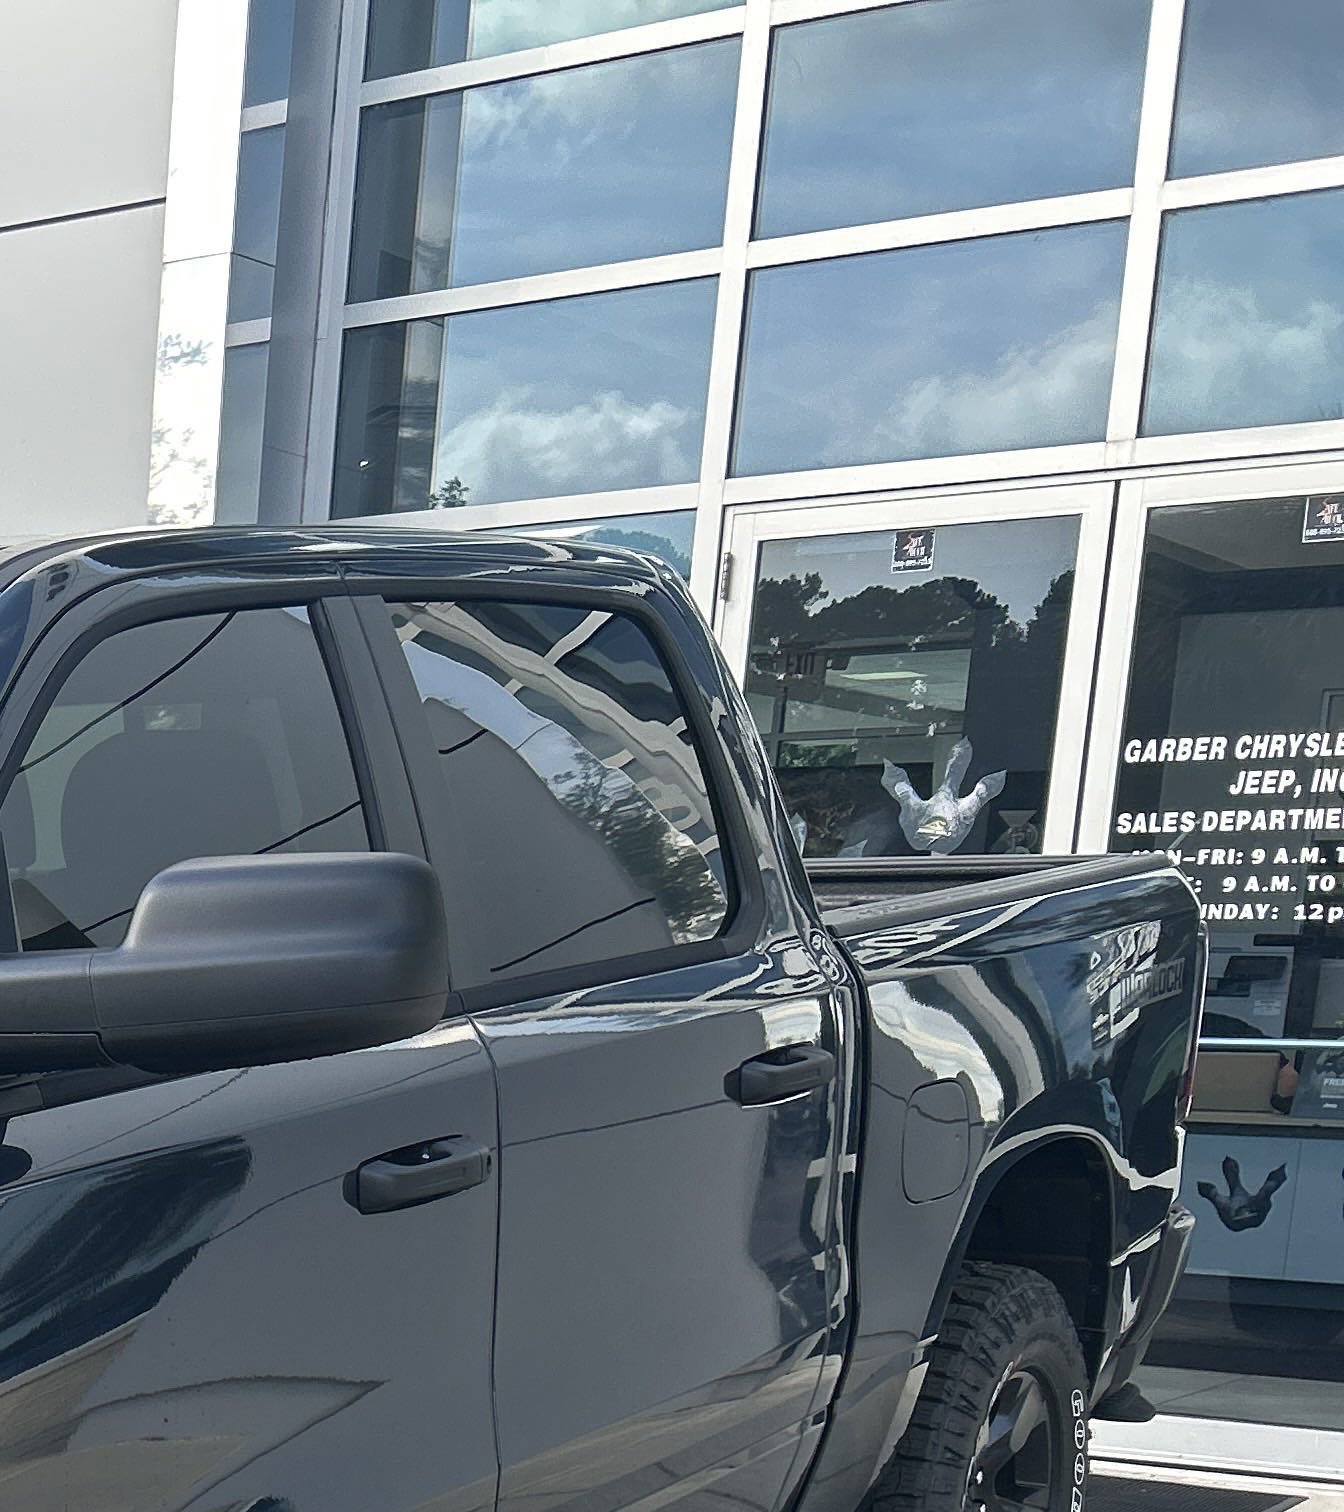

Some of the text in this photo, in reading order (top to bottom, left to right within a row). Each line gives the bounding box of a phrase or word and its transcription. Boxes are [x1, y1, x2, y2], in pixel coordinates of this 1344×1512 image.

[1123, 736, 1228, 764] GARBER
[1229, 767, 1344, 798] JEEP, IN
[1116, 808, 1344, 834] SALES DEPARTME
[1132, 848, 1244, 866] N-FRI:
[1251, 848, 1266, 865] 9
[1273, 847, 1327, 865] A.M.
[1222, 876, 1237, 893] 9
[1244, 875, 1297, 892] A.M.
[1306, 874, 1336, 892] TO
